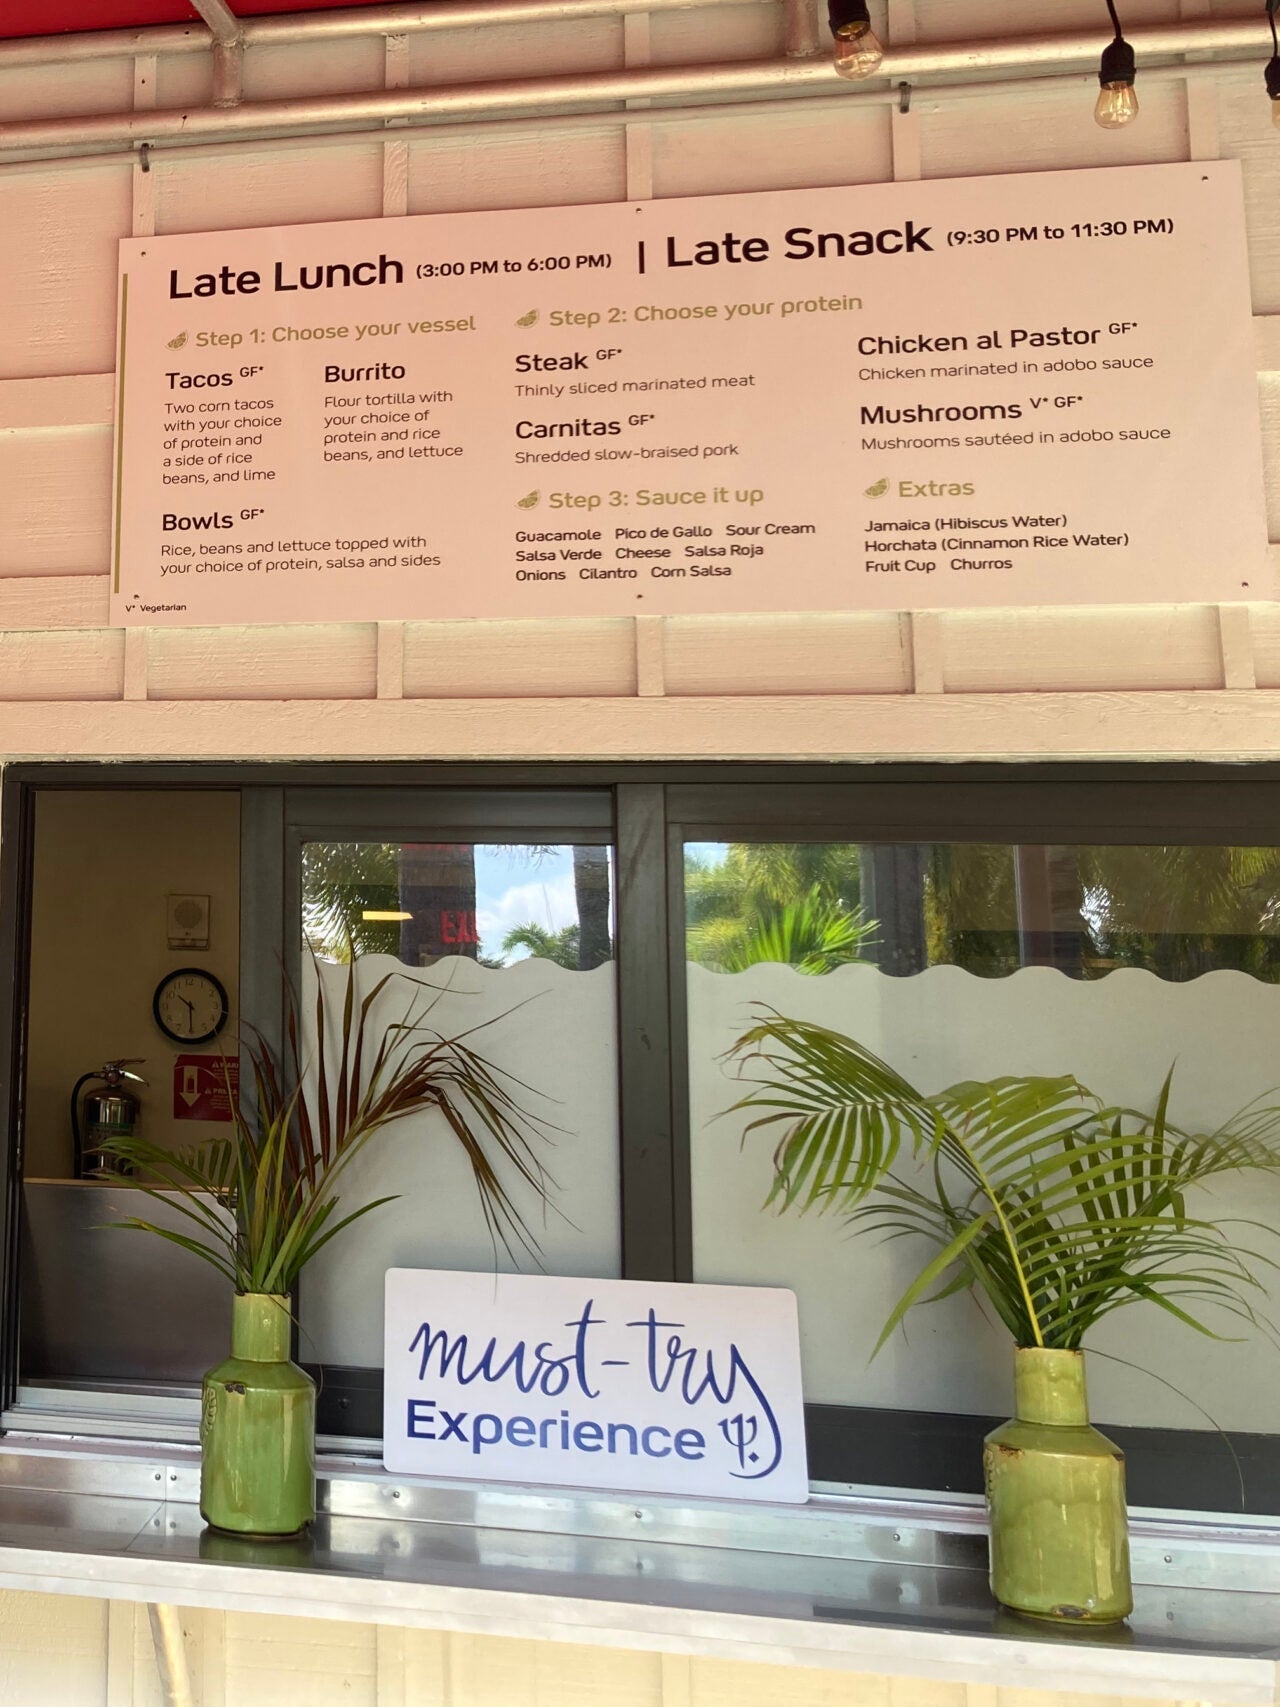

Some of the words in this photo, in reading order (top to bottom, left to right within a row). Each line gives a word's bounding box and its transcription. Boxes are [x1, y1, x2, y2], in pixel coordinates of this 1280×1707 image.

[169, 266, 261, 300] Late
[274, 254, 403, 292] Lunch
[416, 262, 465, 280] (3:00
[470, 260, 498, 275] PM
[502, 259, 522, 273] to
[527, 256, 571, 272] 6:00
[576, 253, 612, 269] PM)
[667, 232, 770, 268] Late
[784, 220, 934, 260] Snack
[947, 229, 1000, 247] (9:30
[1006, 226, 1038, 242] PM
[1043, 225, 1065, 240] to
[1070, 221, 1127, 238] 11:30
[1133, 218, 1174, 235] PM)
[549, 310, 601, 329] Step
[607, 307, 627, 324] 2:
[634, 305, 718, 322] Choose
[724, 302, 775, 321] your
[781, 294, 863, 318] protein
[195, 331, 243, 349] Step
[249, 328, 265, 344] 1:
[272, 326, 349, 343] Choose
[355, 322, 402, 341] your
[407, 315, 477, 334] vessel
[858, 334, 968, 356] Chicken
[976, 330, 1003, 350] al
[1010, 327, 1101, 348] Pastor
[324, 362, 406, 383] Burrito
[515, 352, 589, 373] Steak
[165, 372, 234, 390] Tacos
[514, 384, 565, 398] Thinly
[569, 381, 618, 395] sliced
[622, 377, 707, 391] marinated
[711, 374, 755, 388] meat
[860, 404, 1023, 425] Mushrooms
[515, 418, 622, 439] Carnitas
[861, 437, 960, 450] Mushrooms
[964, 432, 1034, 447] sautéed
[1039, 431, 1054, 444] in
[1059, 429, 1114, 443] adobo
[1118, 429, 1171, 441] sauce
[515, 449, 591, 464] Shredded
[594, 445, 699, 461] slow-braised
[703, 444, 739, 459] pork
[549, 492, 602, 512] Step
[608, 490, 629, 507] 3:
[636, 489, 707, 506] Sauce
[713, 487, 729, 504] it
[735, 489, 764, 507] up
[898, 480, 975, 498] Extras
[162, 512, 234, 531] Bowls
[864, 519, 931, 532] Jamaica
[934, 517, 1009, 532] (Hibiscus
[1011, 514, 1067, 528] Water)
[864, 539, 937, 552] Horchata
[941, 538, 1029, 552] (Cinnamon
[1033, 535, 1069, 548] Rice
[1072, 533, 1129, 547] Water)
[865, 560, 901, 573] Fruit
[904, 559, 936, 574] Cup
[950, 558, 1013, 571] Churros
[139, 603, 187, 614] Vegetarian
[409, 1299, 782, 1479] must-try
[407, 1398, 705, 1460] Experience
